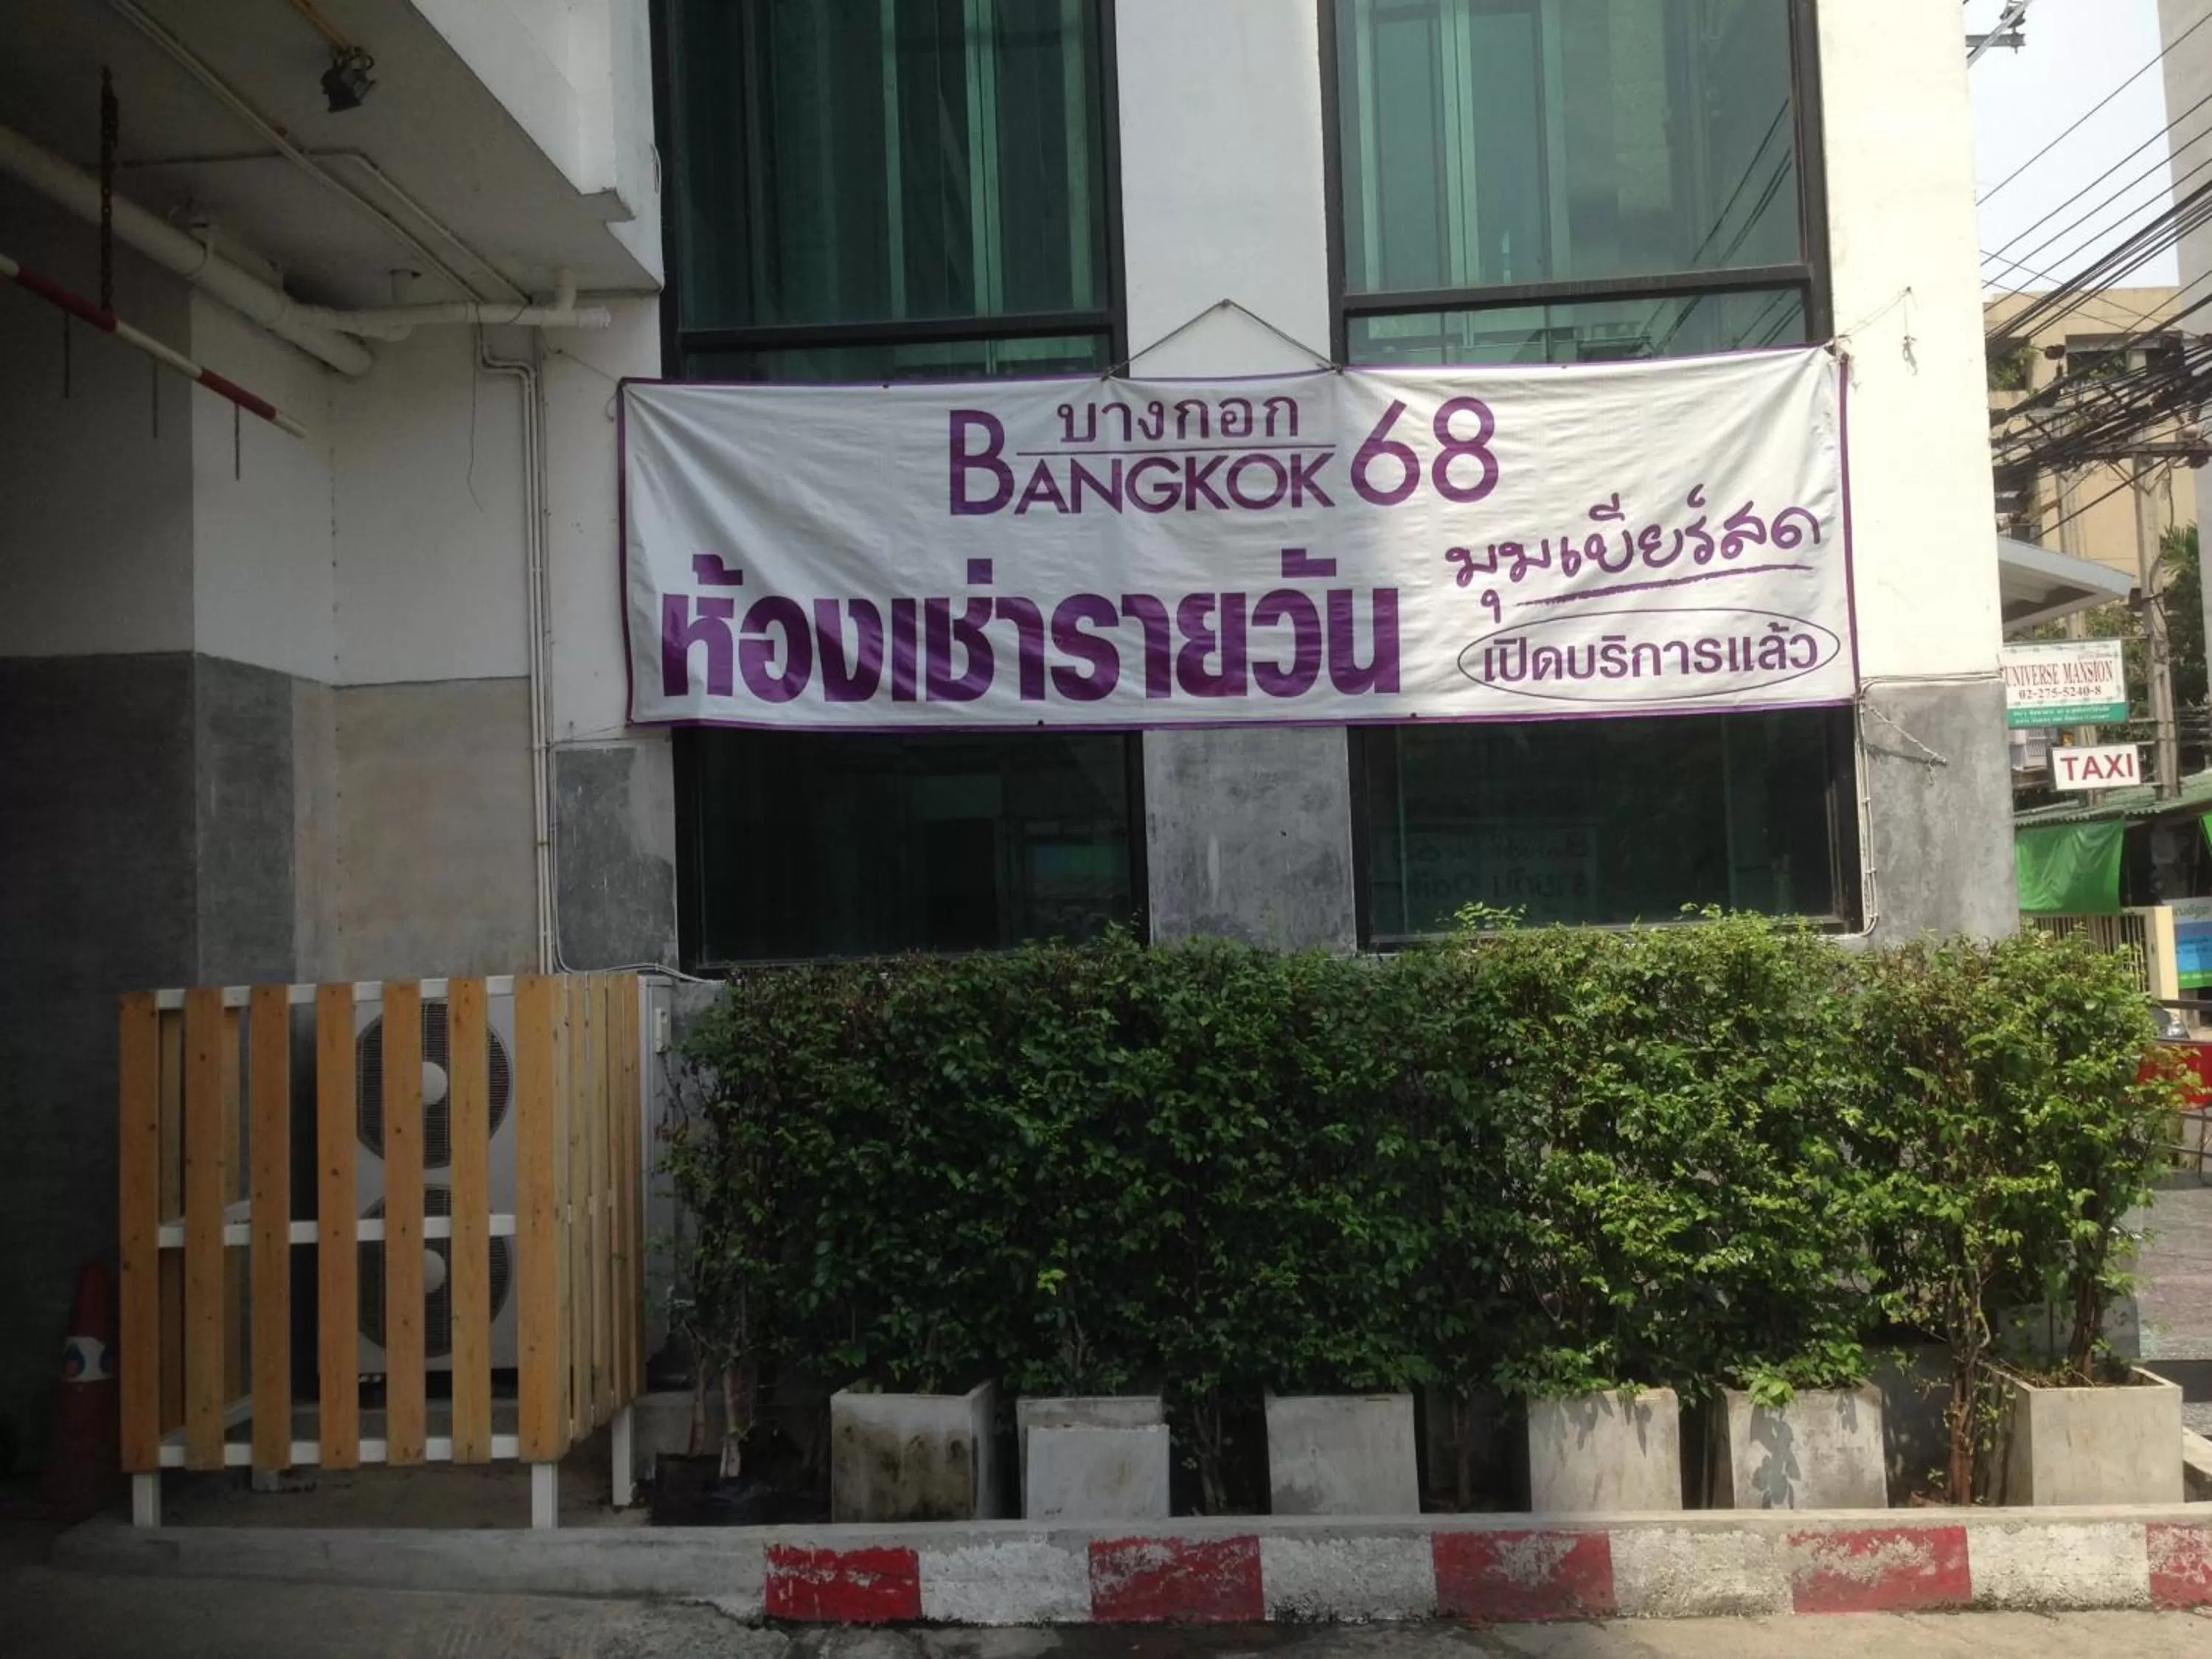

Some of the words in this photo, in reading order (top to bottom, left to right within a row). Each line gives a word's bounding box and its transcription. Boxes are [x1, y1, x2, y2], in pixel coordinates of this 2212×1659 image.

[1058, 396, 1298, 442] บางกอก
[950, 409, 1335, 515] BANGKOK
[1351, 396, 1500, 506] 68
[1445, 484, 1820, 624] มุมเบียร์สด
[661, 549, 1401, 703] ห้องเช่ารายวัน
[1484, 622, 1818, 683] เปิดบริการแล้ว
[2004, 664, 2059, 687] UNIVERSE
[2062, 661, 2113, 684] MANSION
[2060, 754, 2134, 781] TAXI
